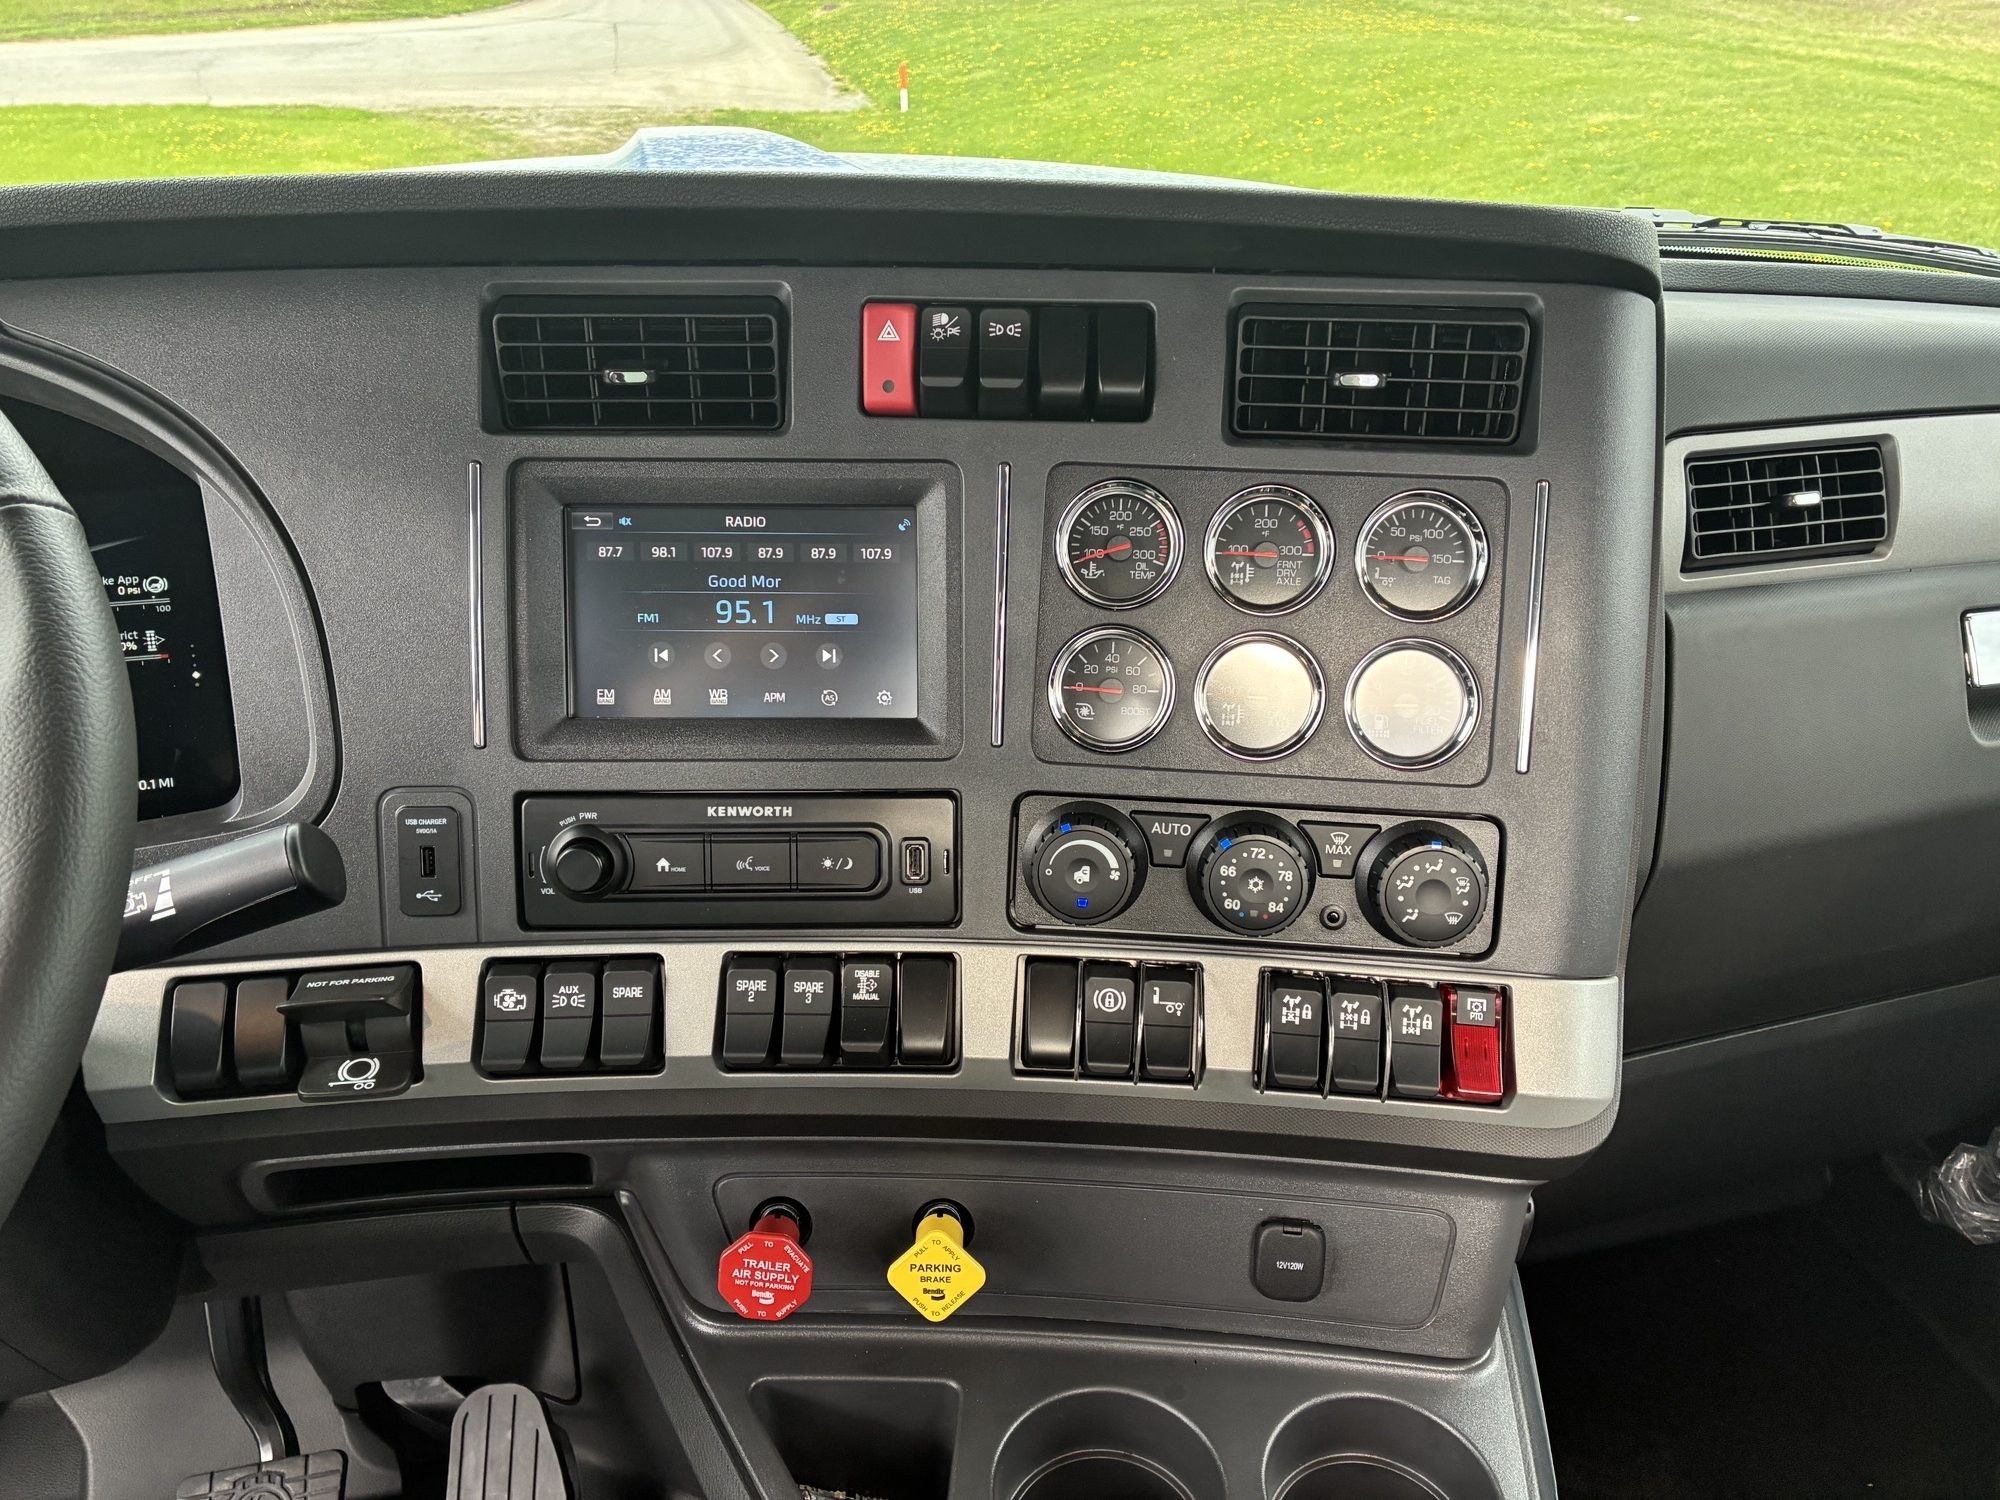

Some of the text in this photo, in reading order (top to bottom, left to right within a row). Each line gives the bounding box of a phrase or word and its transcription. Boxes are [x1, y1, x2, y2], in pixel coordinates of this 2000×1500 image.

[1109, 511, 1132, 520] 200
[725, 516, 767, 528] RADIO
[1254, 518, 1278, 529] 200
[1089, 526, 1109, 536] 150
[1129, 526, 1151, 537] 250
[1390, 527, 1406, 537] 50
[1422, 528, 1444, 539] 100
[1409, 534, 1423, 542] PSI
[598, 546, 892, 560] 87.7 98.1 107.9 87.9 87.9 107.9
[1132, 550, 1156, 560] 300
[1278, 545, 1303, 556] 300
[1276, 560, 1303, 569] FRNT
[1432, 554, 1452, 564] 150
[1136, 562, 1149, 571] OIL
[1130, 570, 1156, 580] TEMP
[1276, 568, 1297, 577] DRV
[117, 576, 139, 586] App
[708, 575, 782, 589] Good Mor
[1276, 578, 1301, 586] AXLE
[1433, 576, 1451, 585] TAG
[118, 586, 141, 595] 0 PSI
[156, 604, 172, 613] 100
[716, 600, 822, 626] 95.1 MHz
[637, 613, 660, 624] FM1
[1104, 654, 1121, 663] 40
[1084, 664, 1099, 674] 20
[1126, 666, 1141, 676] 60
[1076, 682, 1084, 692] 0
[1132, 684, 1147, 694] 80
[596, 688, 615, 699] FM
[654, 688, 672, 699] AM
[708, 688, 728, 699] WB
[764, 692, 786, 703] APM
[824, 694, 835, 702] AS
[1120, 706, 1151, 716] BOOST
[158, 777, 174, 789] MI
[707, 806, 793, 817] KENWORTH
[405, 818, 418, 826] USB
[559, 812, 598, 827] PUSH PWR
[1151, 822, 1192, 837] AUTO
[1250, 848, 1266, 860] 72
[1325, 845, 1352, 856] MAX
[1220, 865, 1237, 877] 66
[1278, 870, 1293, 882] 78
[1224, 900, 1241, 911] 60
[1268, 902, 1284, 913] 84
[854, 970, 880, 978] DISABLE
[329, 979, 350, 987] FOR
[351, 976, 395, 984] PARKING
[736, 980, 767, 992] SPARE
[558, 986, 579, 994] AUX
[612, 986, 643, 998] SPARE
[794, 982, 824, 993] SPARE
[748, 991, 755, 1003] 2
[805, 992, 812, 1004] 3
[1470, 1012, 1484, 1021] PTO
[738, 1240, 810, 1273] PULL TO EVACUATE
[914, 1246, 929, 1258] PULL
[943, 1245, 960, 1261] APPLY
[742, 1258, 791, 1272] TRAILER
[910, 1264, 962, 1273] PARKING
[1276, 1261, 1304, 1271] 12V120W
[732, 1268, 800, 1284] AIR SUPPLY
[920, 1276, 952, 1284] BRAKE
[765, 1282, 795, 1291] PARKING
[751, 1290, 775, 1298] Bendix
[913, 1297, 928, 1312] PUSH
[942, 1290, 966, 1312] RELEASE
[733, 1299, 749, 1314] PUSH
[776, 1299, 798, 1318] SUPPLY
